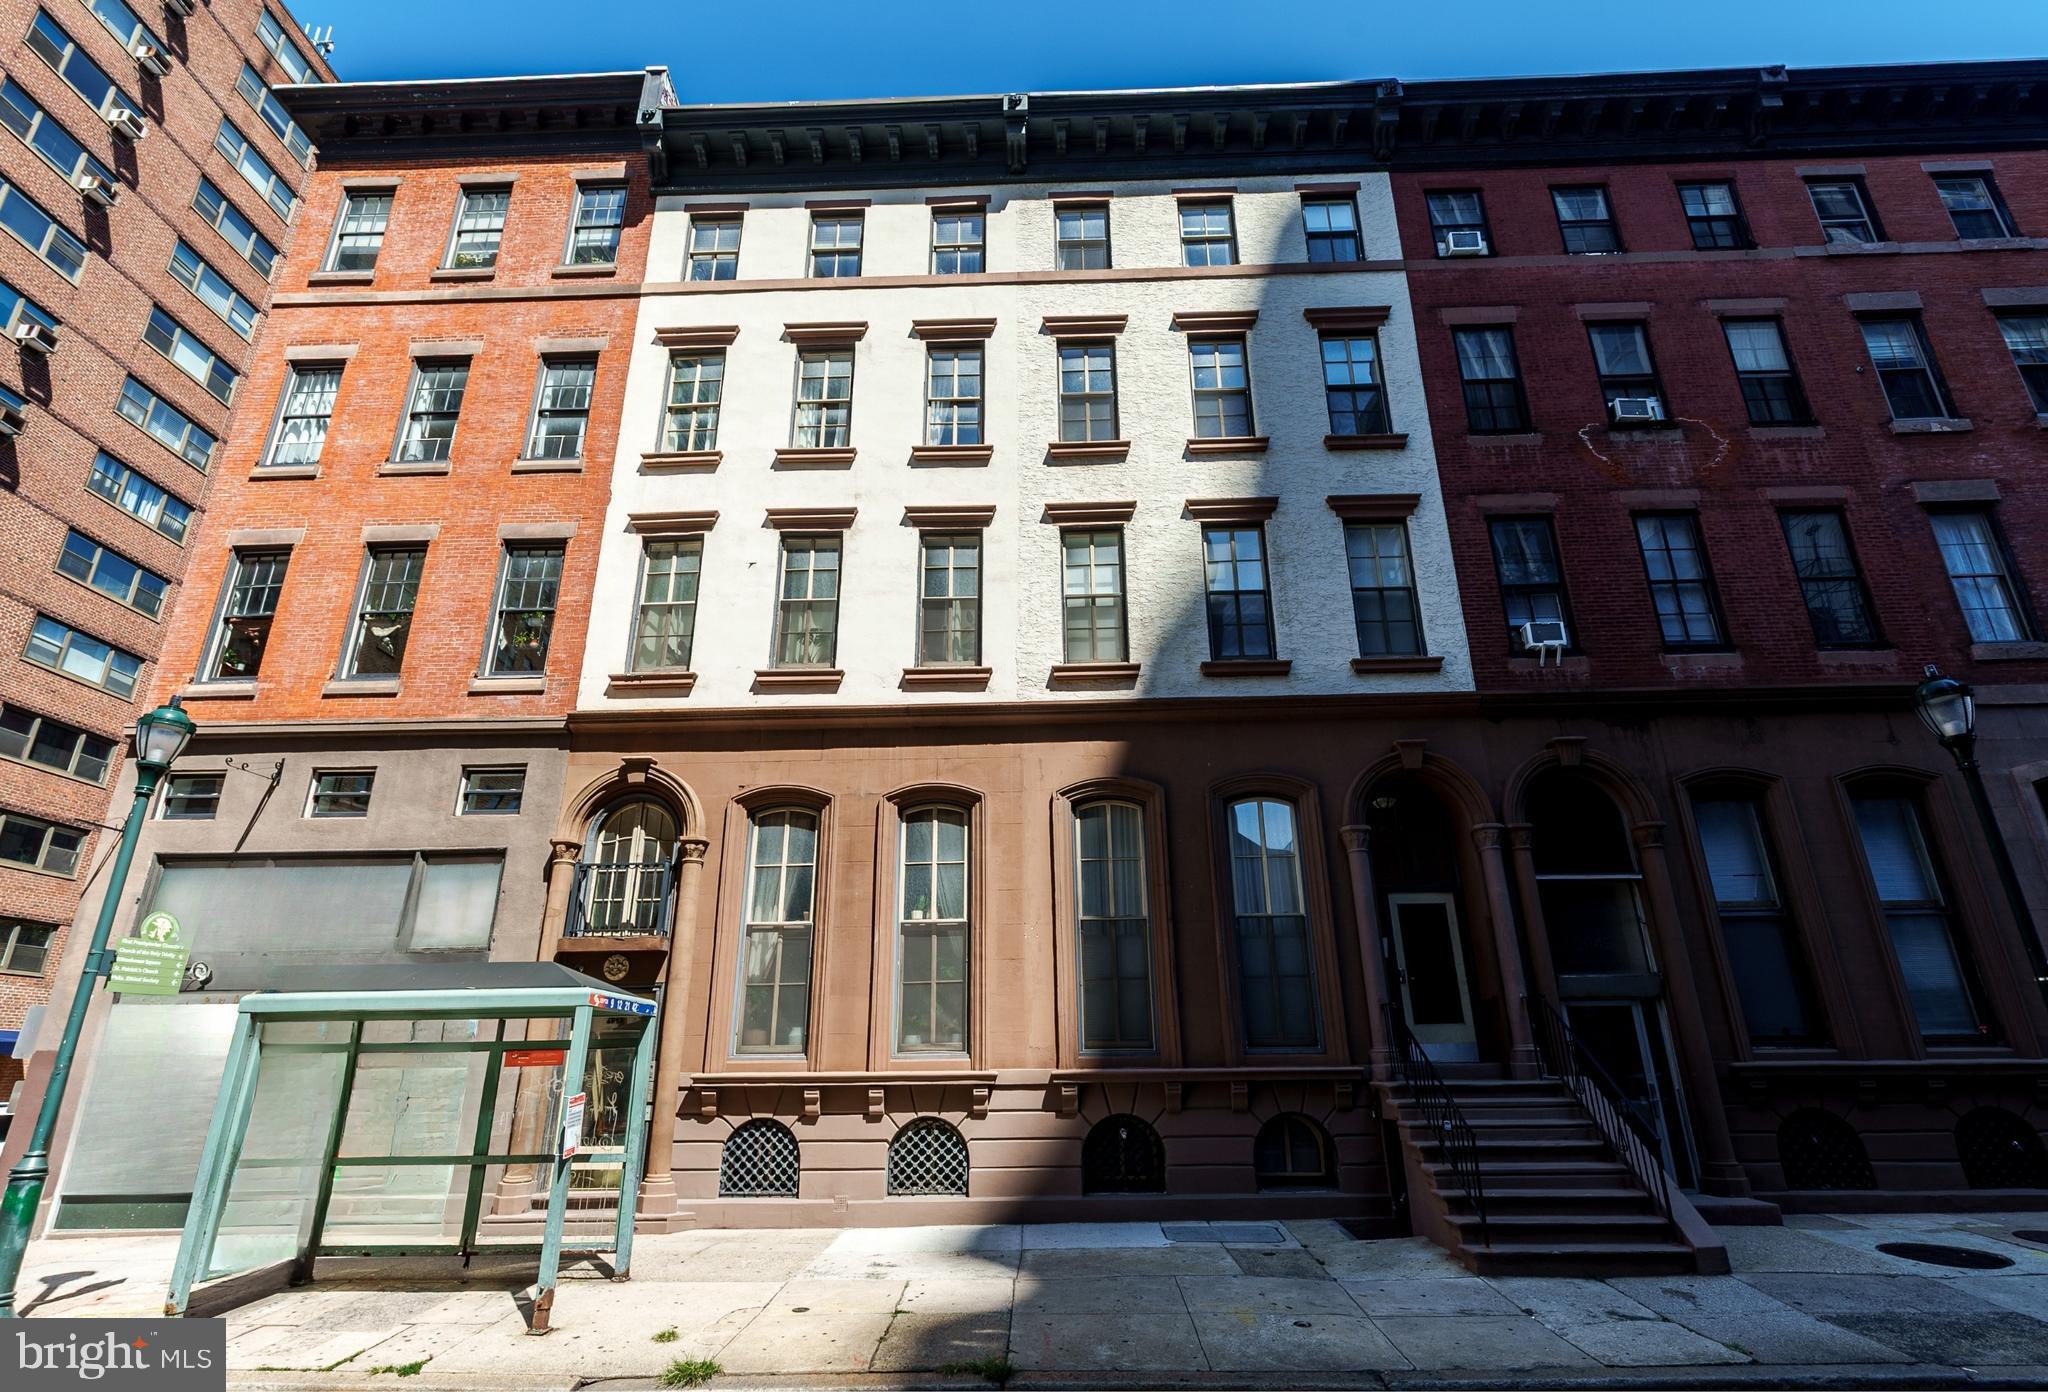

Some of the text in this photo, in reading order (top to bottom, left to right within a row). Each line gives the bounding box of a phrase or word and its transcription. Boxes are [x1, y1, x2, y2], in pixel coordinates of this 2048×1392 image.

[611, 998, 615, 1008] 9
[617, 1000, 623, 1010] 12
[625, 1001, 631, 1011] 21
